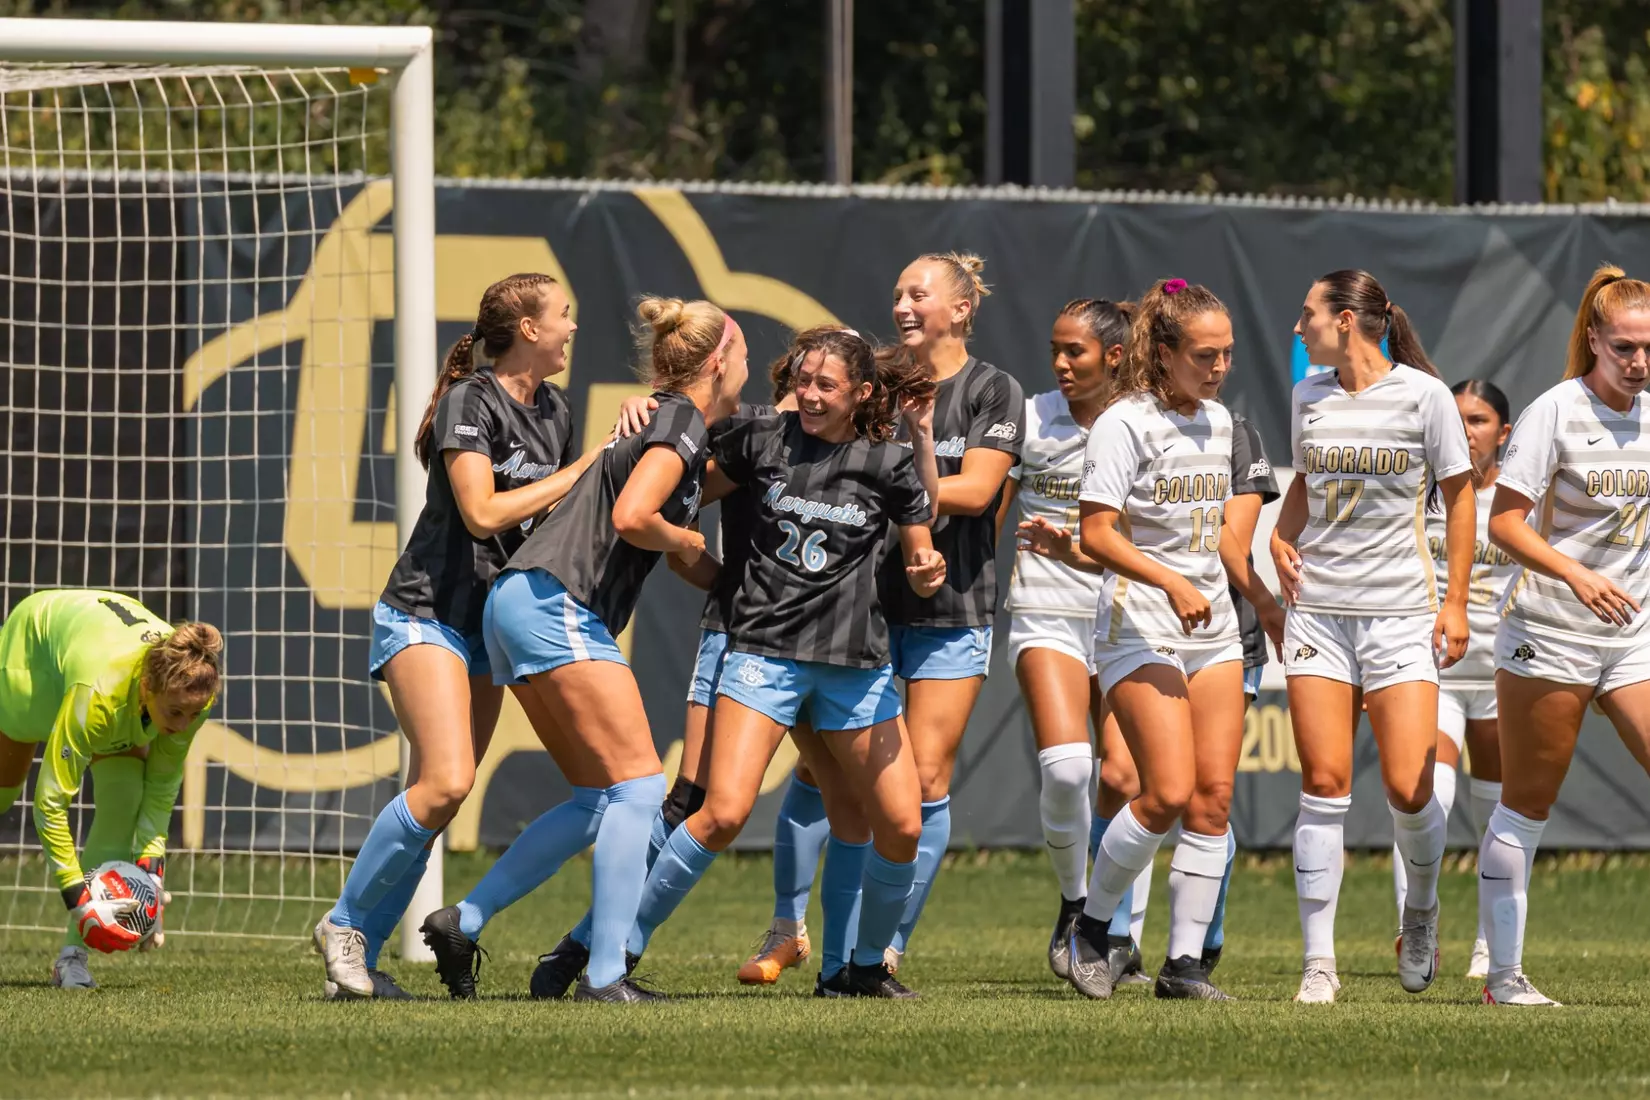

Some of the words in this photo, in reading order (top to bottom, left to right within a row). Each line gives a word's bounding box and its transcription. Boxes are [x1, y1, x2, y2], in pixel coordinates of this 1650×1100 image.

[1303, 446, 1410, 475] OLORADO
[762, 481, 867, 526] Marquette
[1032, 473, 1081, 501] COLO
[1153, 473, 1229, 505] COLORA
[1324, 479, 1366, 523] 17
[1586, 469, 1650, 498] COLOR
[776, 520, 828, 572] 26
[1188, 506, 1223, 553] 13
[1606, 501, 1650, 547] 21
